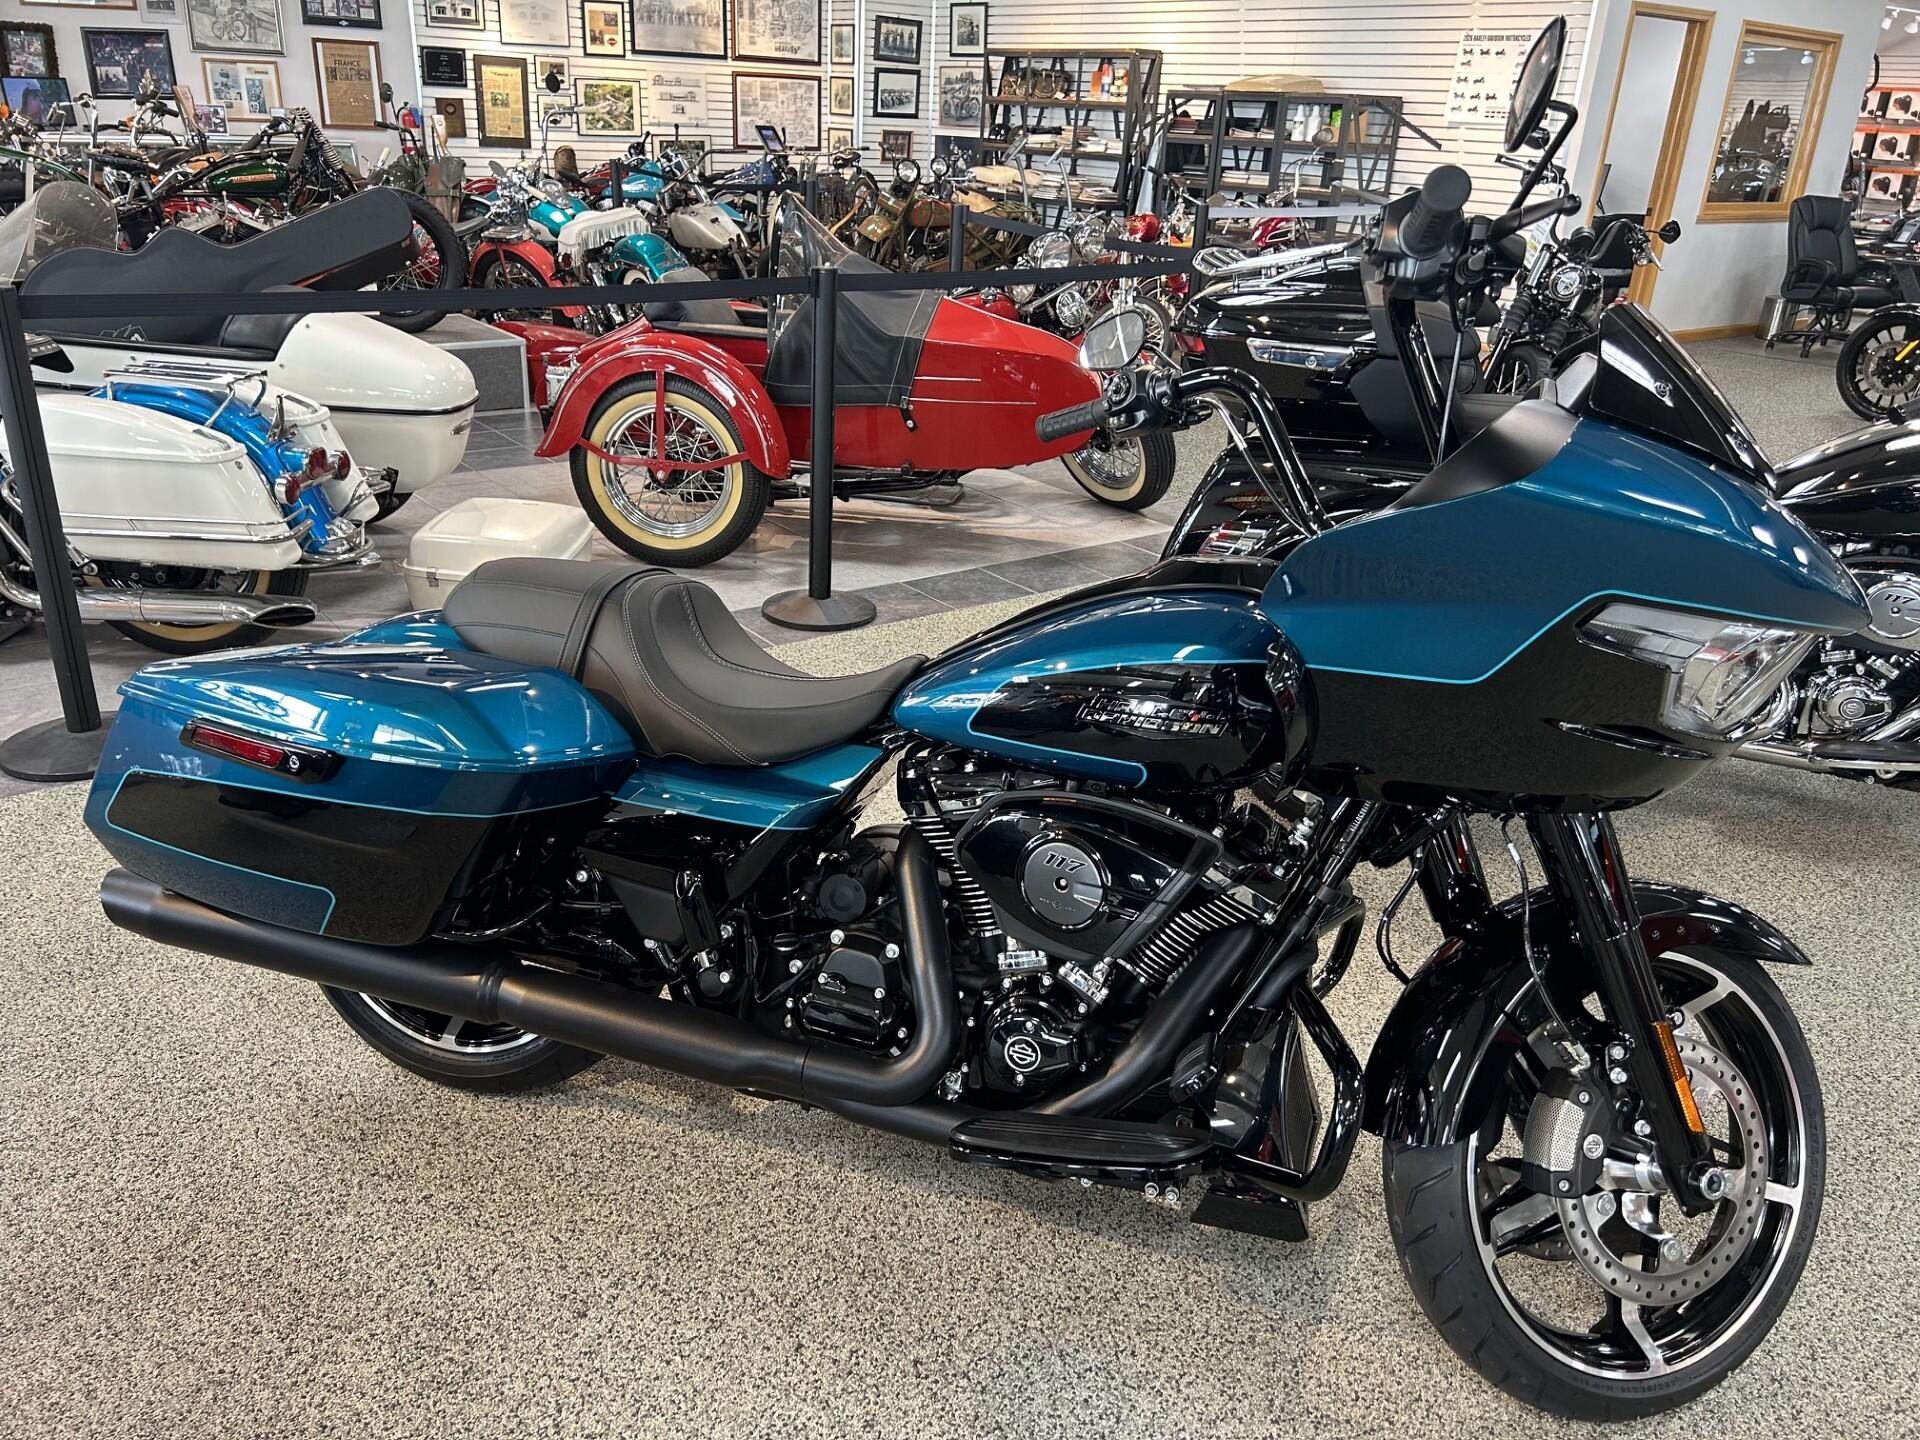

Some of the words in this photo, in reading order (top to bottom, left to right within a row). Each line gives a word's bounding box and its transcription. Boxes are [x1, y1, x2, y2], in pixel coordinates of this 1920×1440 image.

[334, 58, 361, 67] FRANCE
[1884, 593, 1915, 604] 117
[1043, 851, 1087, 873] 117
